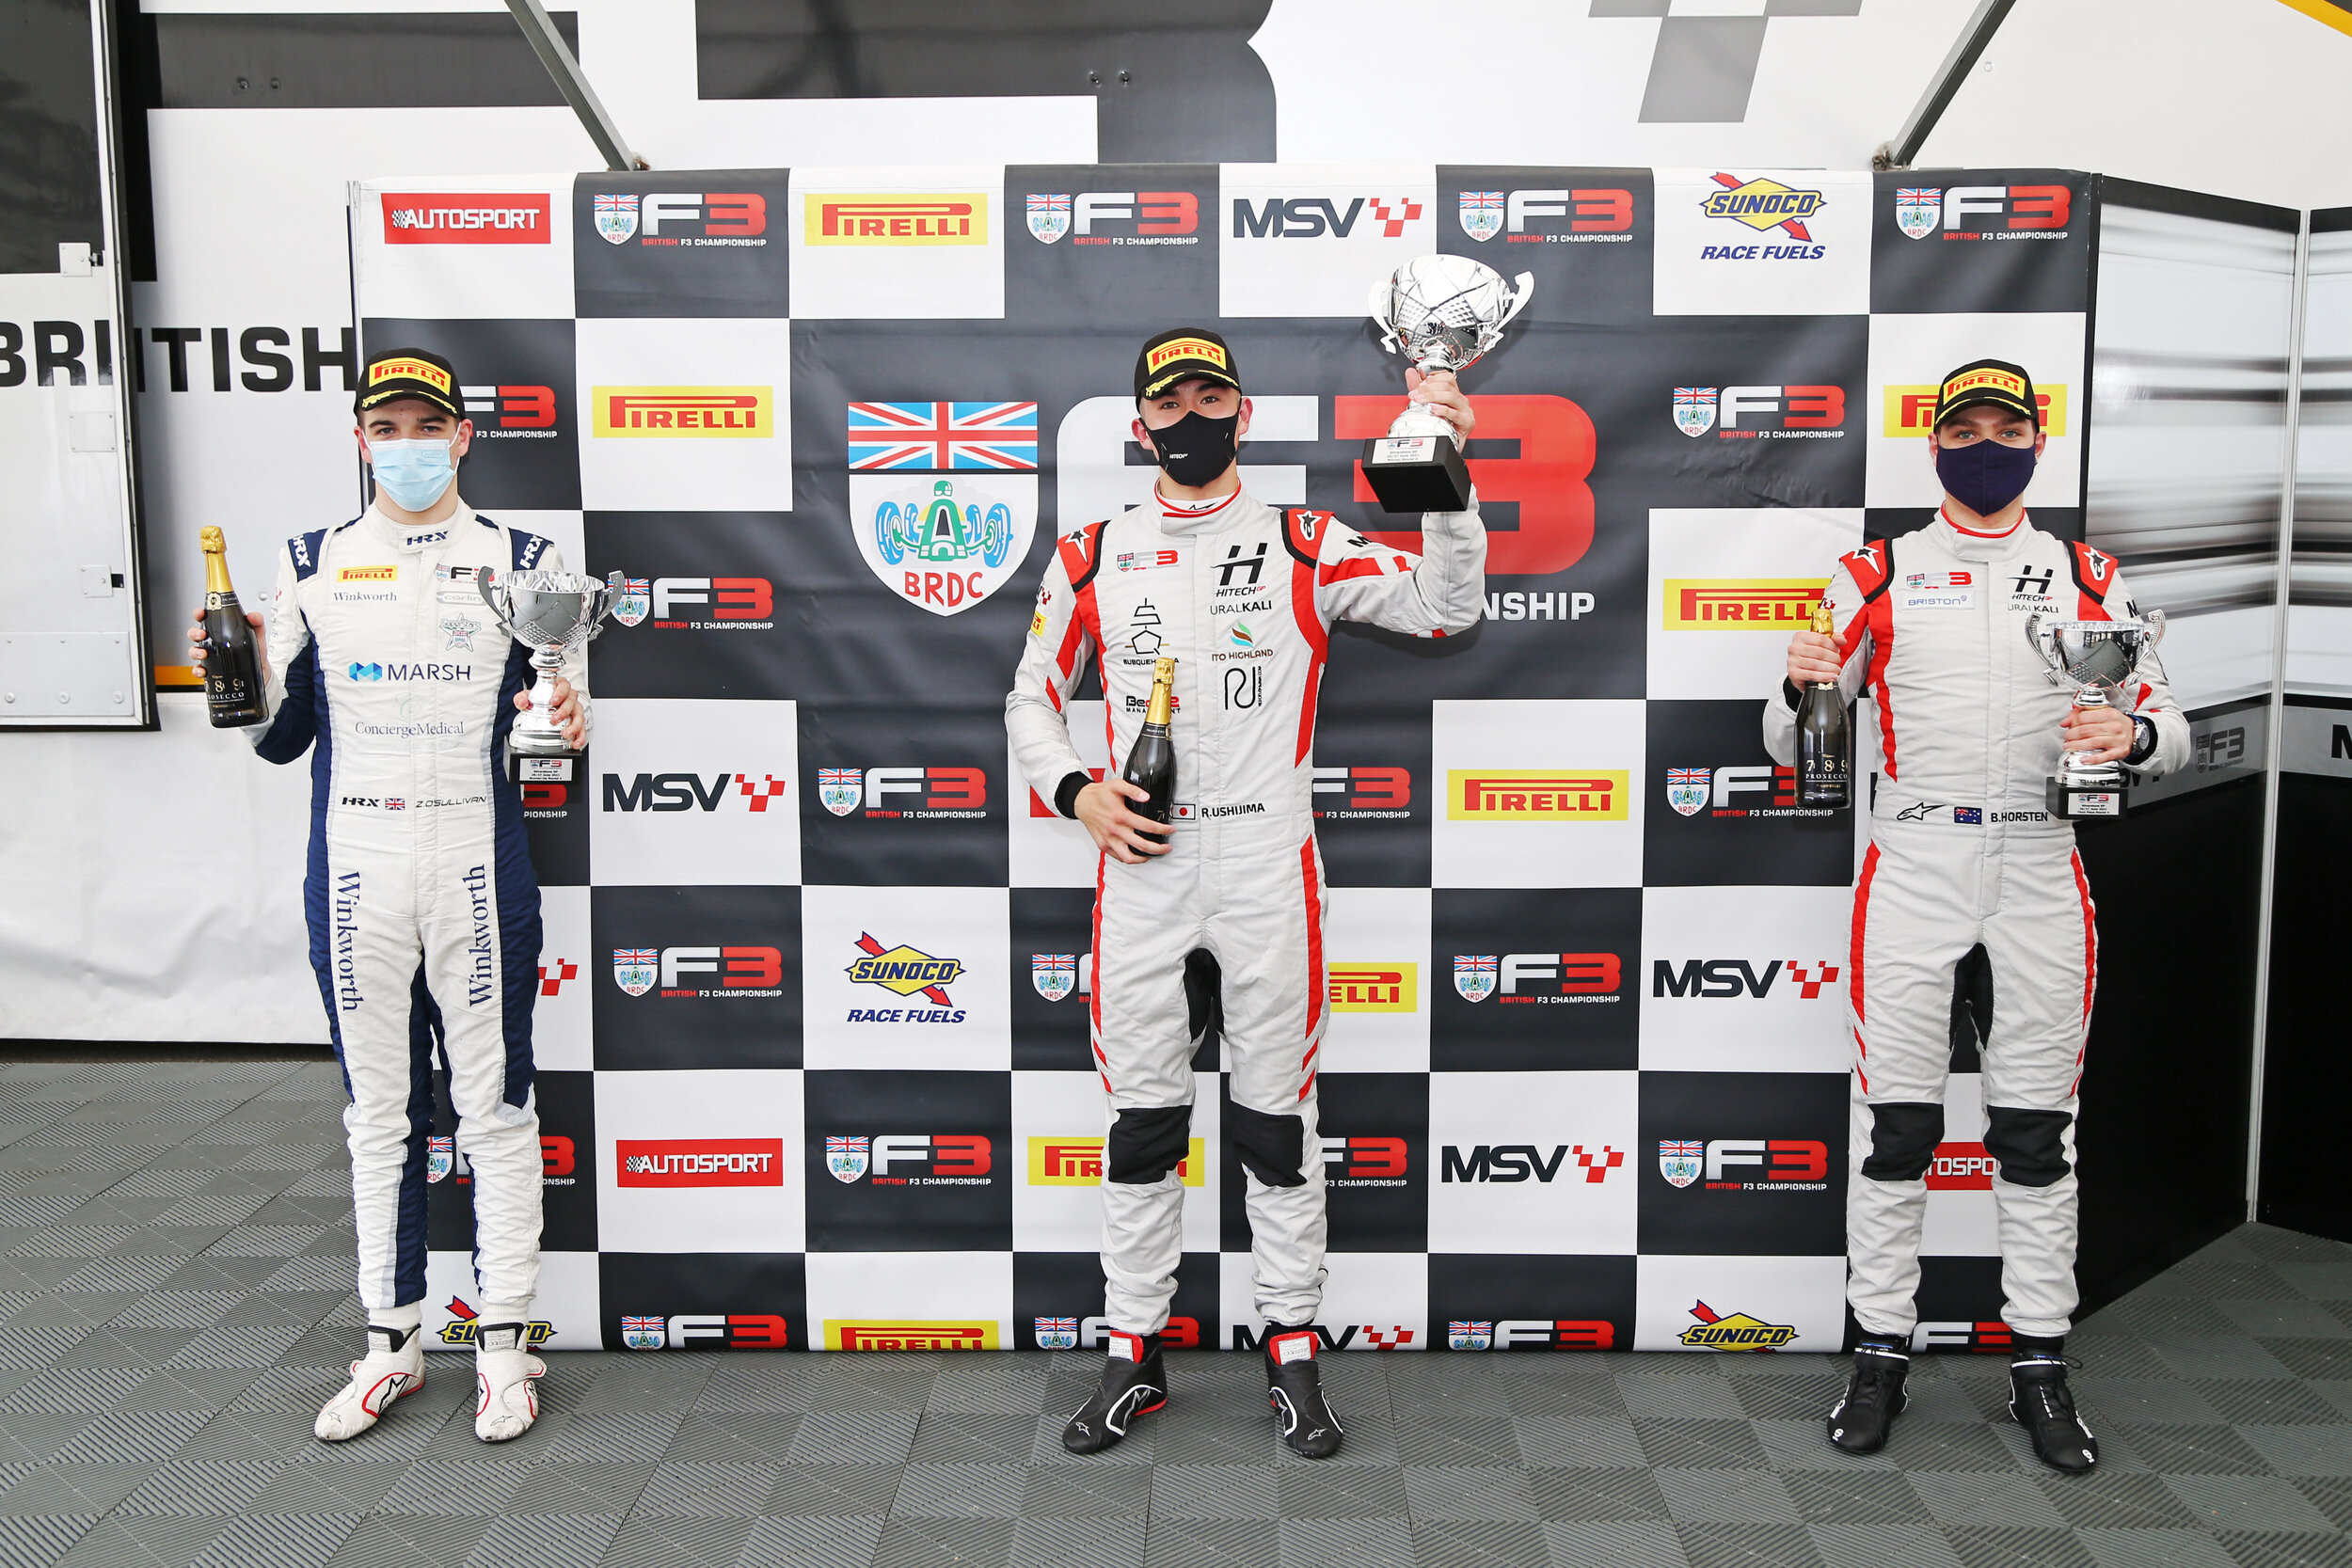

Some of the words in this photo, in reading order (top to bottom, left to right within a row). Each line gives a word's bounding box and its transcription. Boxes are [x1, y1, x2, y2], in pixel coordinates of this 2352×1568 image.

[643, 194, 767, 235] F3
[1074, 192, 1199, 234] F3
[1508, 189, 1633, 232] F3
[1709, 195, 1817, 214] SUNOCO
[1944, 185, 2071, 230] F3
[405, 208, 540, 230] AUTOSPORT
[823, 203, 972, 236] PIRELLI
[1233, 198, 1364, 238] MSV
[607, 233, 627, 243] BRDC
[1039, 231, 1058, 241] BRDC
[1472, 230, 1491, 239] BRDC
[1507, 234, 1544, 243] BRITISH
[1547, 234, 1557, 243] F3
[1561, 234, 1632, 243] CHAMPIONSHIP
[1907, 228, 1927, 237] BRDC
[1701, 246, 1759, 260] RACE
[1762, 245, 1826, 260] FUELS
[1152, 341, 1221, 367] PIRELLI
[373, 361, 446, 388] PIRELLI
[1947, 372, 2020, 397] PIRELLI
[610, 395, 757, 429] PIRELLI
[1721, 386, 1845, 428] F3
[1684, 426, 1704, 435] BRDC
[406, 531, 449, 546] HRX
[519, 535, 544, 569] HRX
[342, 567, 393, 579] PIRELLI
[333, 592, 397, 602] Winkworth
[653, 578, 773, 619] F3
[905, 571, 984, 608] BRDC
[1216, 586, 1257, 597] HITECH
[1210, 600, 1272, 615] URALKALI
[1680, 588, 1825, 621] PIRELL
[1908, 597, 1962, 607] BRISTON
[620, 616, 640, 626] BRDC
[1212, 654, 1227, 662] ITO
[1229, 649, 1274, 660] HIGHLAND
[388, 663, 470, 681] MARSH
[355, 721, 464, 738] ConciergeMedical
[603, 773, 731, 812] MSV
[866, 768, 986, 808] F3
[1465, 779, 1613, 812] PIRELLI
[342, 797, 380, 807] HRX
[831, 806, 850, 816] BRDC
[1201, 802, 1265, 819] R.USHIJIMA
[1677, 805, 1697, 815] BRDC
[1991, 812, 2048, 823] B.HORSTEN
[336, 871, 364, 1011] Winkworth
[462, 863, 493, 1007] Winkworth
[661, 946, 782, 987] F3
[854, 961, 956, 980] SUNOCO
[1501, 953, 1621, 993] F3
[1653, 960, 1782, 998] MSV
[627, 986, 645, 995] BRDC
[1044, 990, 1063, 1000] BRDC
[1465, 992, 1485, 1001] BRDC
[847, 1009, 903, 1022] RACE
[905, 1009, 966, 1023] FUELS
[643, 1153, 772, 1174] AUTOSPORT
[871, 1135, 992, 1176] F3
[1442, 1145, 1568, 1182] MSV
[1707, 1140, 1827, 1180] F3
[837, 1173, 857, 1182] BRDC
[1671, 1178, 1690, 1187] BRDC
[668, 1315, 787, 1348] F3
[841, 1327, 984, 1351] PIRELLI
[1493, 1321, 1614, 1350] F3
[1686, 1327, 1789, 1345] SUNOCO
